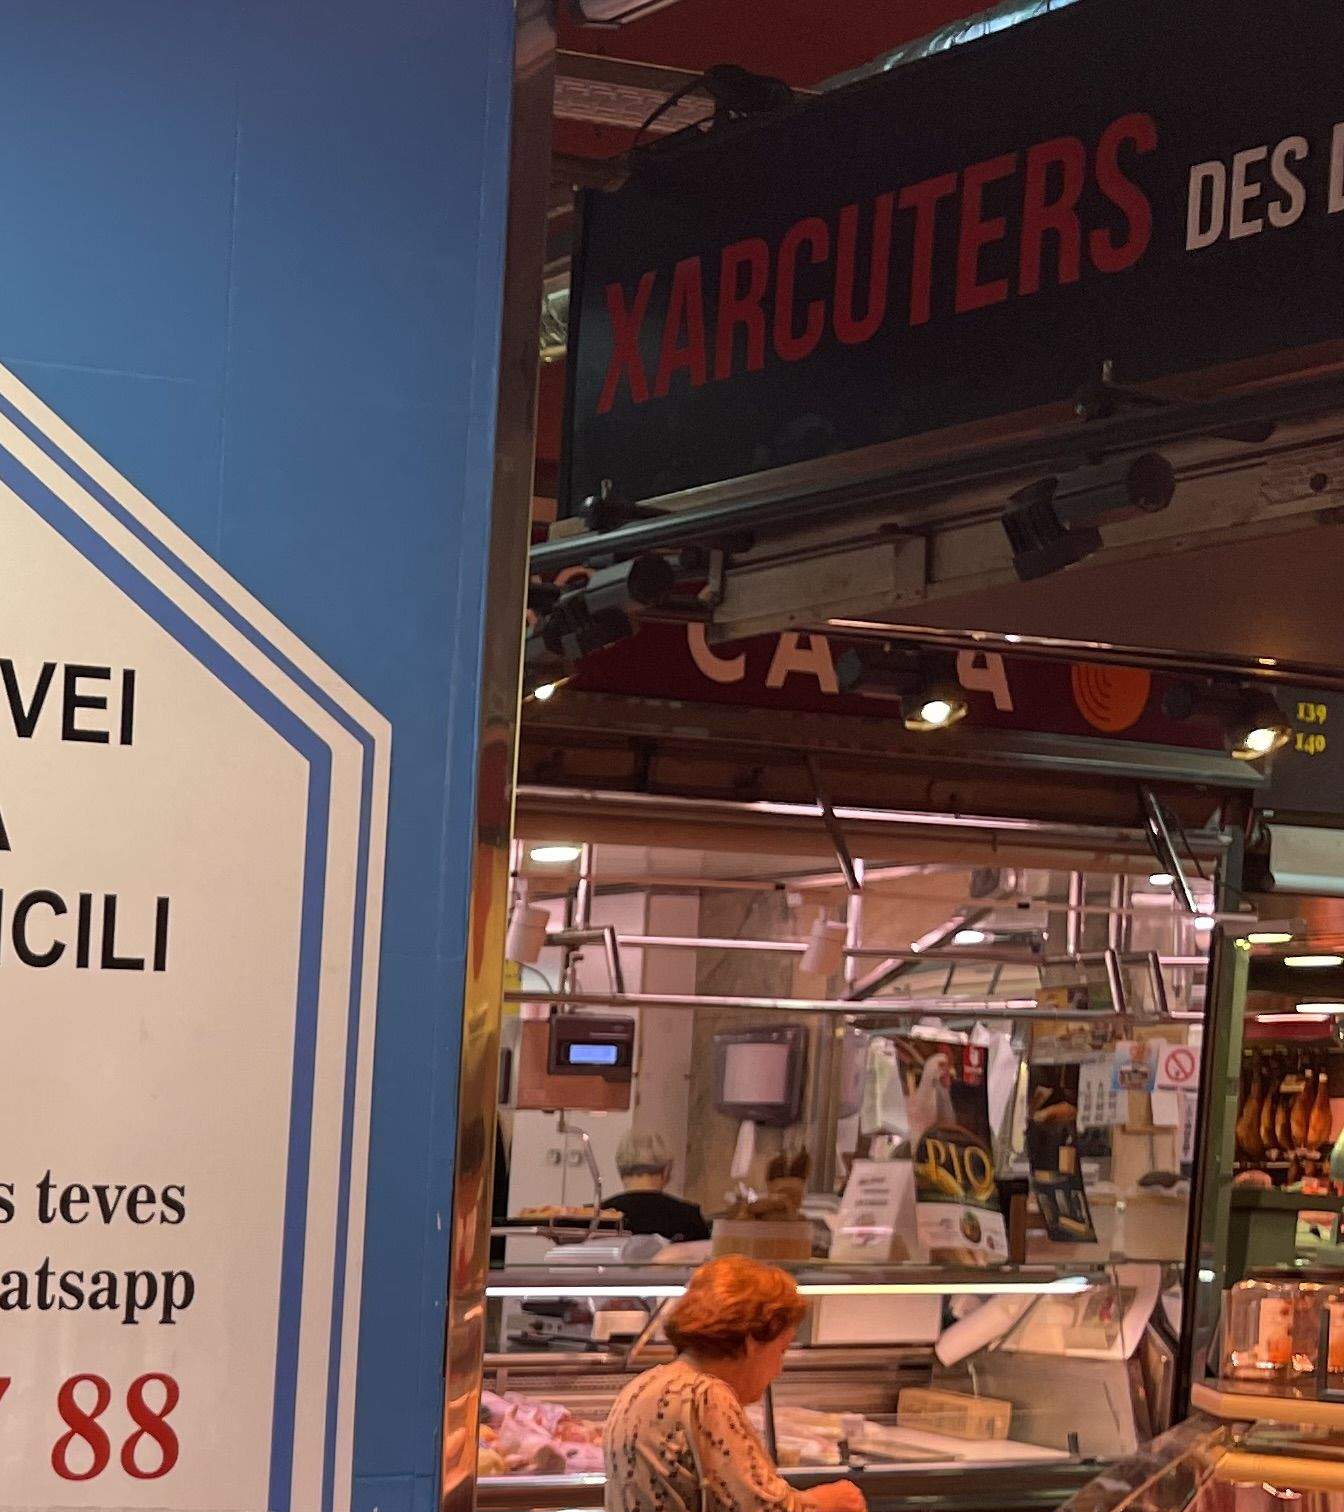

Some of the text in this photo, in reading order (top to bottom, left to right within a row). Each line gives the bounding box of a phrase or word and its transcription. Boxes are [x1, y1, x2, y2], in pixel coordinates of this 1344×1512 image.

[596, 112, 1159, 414] XARCUTERS
[1185, 136, 1309, 251] DES
[35, 1169, 186, 1225] teves
[51, 1372, 179, 1481] 88
